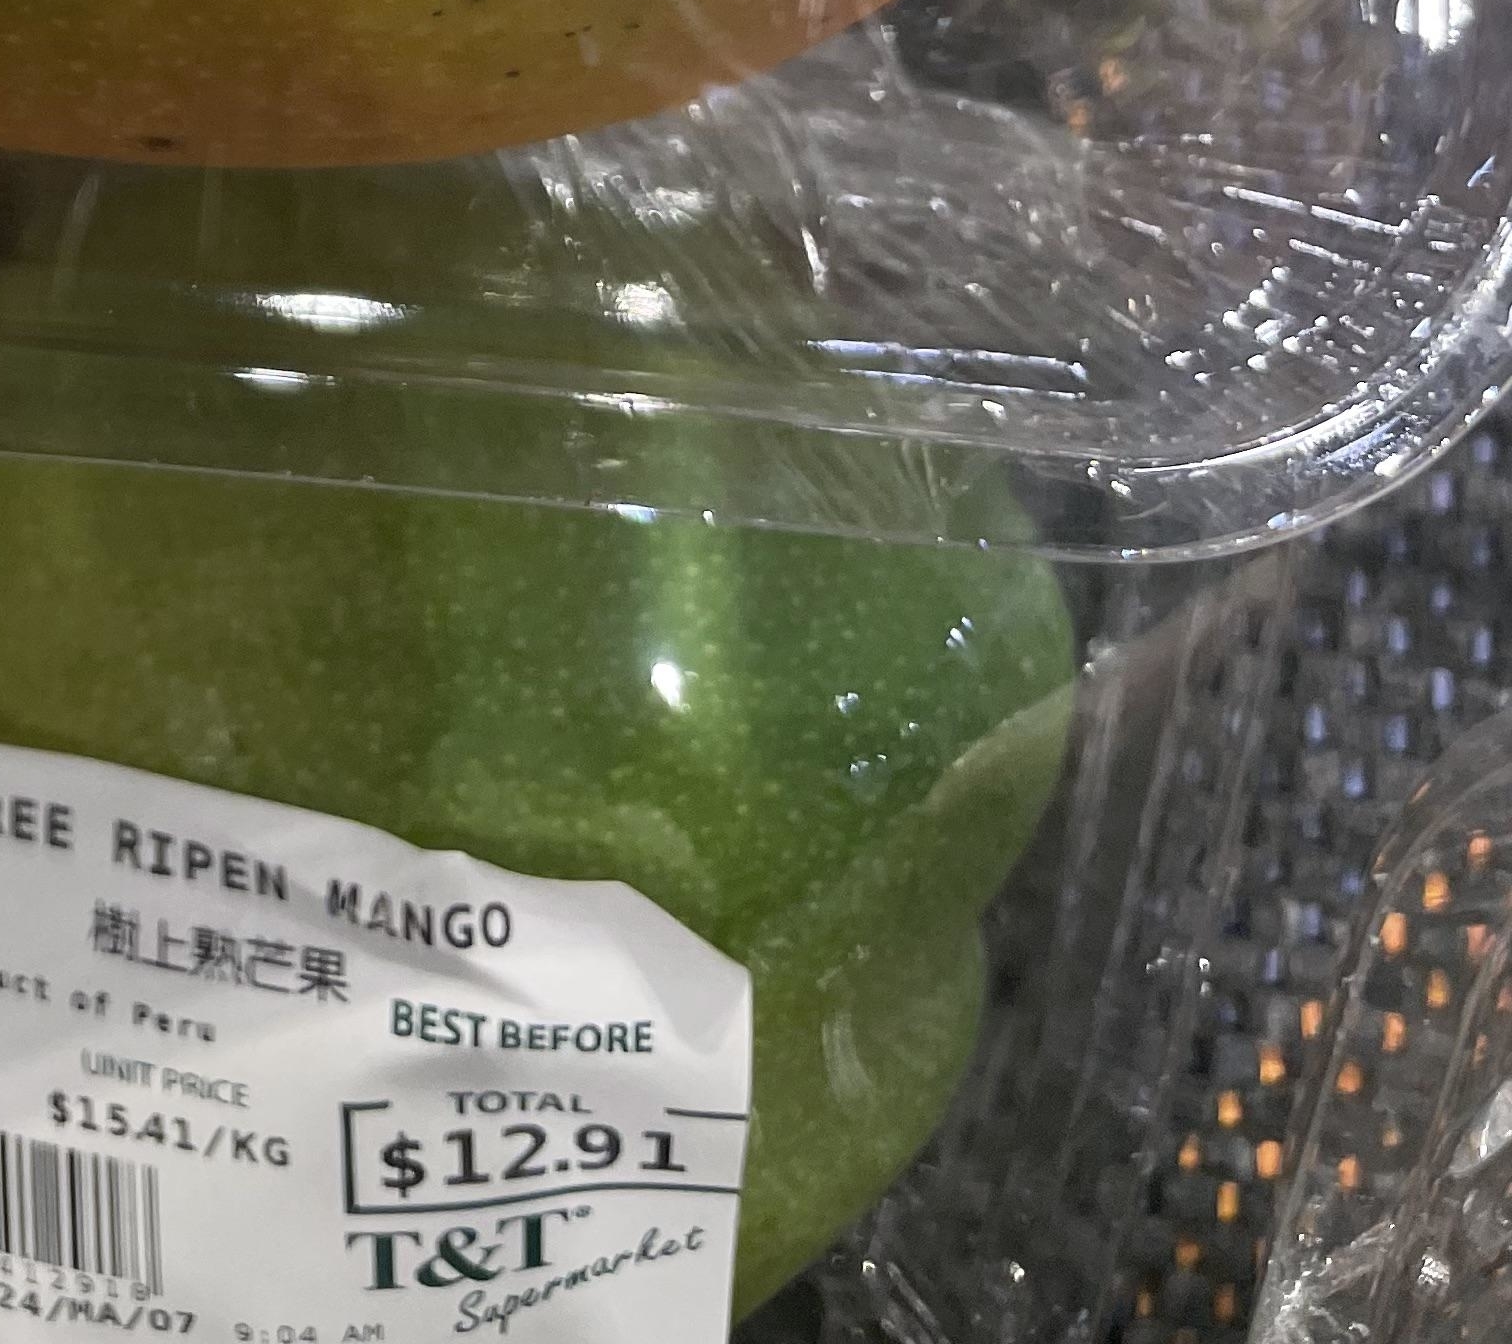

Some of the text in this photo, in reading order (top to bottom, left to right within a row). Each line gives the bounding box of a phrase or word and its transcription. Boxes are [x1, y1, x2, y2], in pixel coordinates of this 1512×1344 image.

[112, 817, 288, 902] RIPEN
[325, 878, 513, 949] MANGO
[89, 898, 352, 1006] 樹上熟芒果
[70, 990, 112, 1015] of
[131, 1000, 217, 1044] Peru
[390, 997, 655, 1054] BEST BEFORE
[82, 1046, 250, 1109] UNIT PRICE
[447, 1089, 593, 1115] TOTAL
[381, 1123, 688, 1199] $12.91
[452, 1224, 705, 1335] Supermarket
